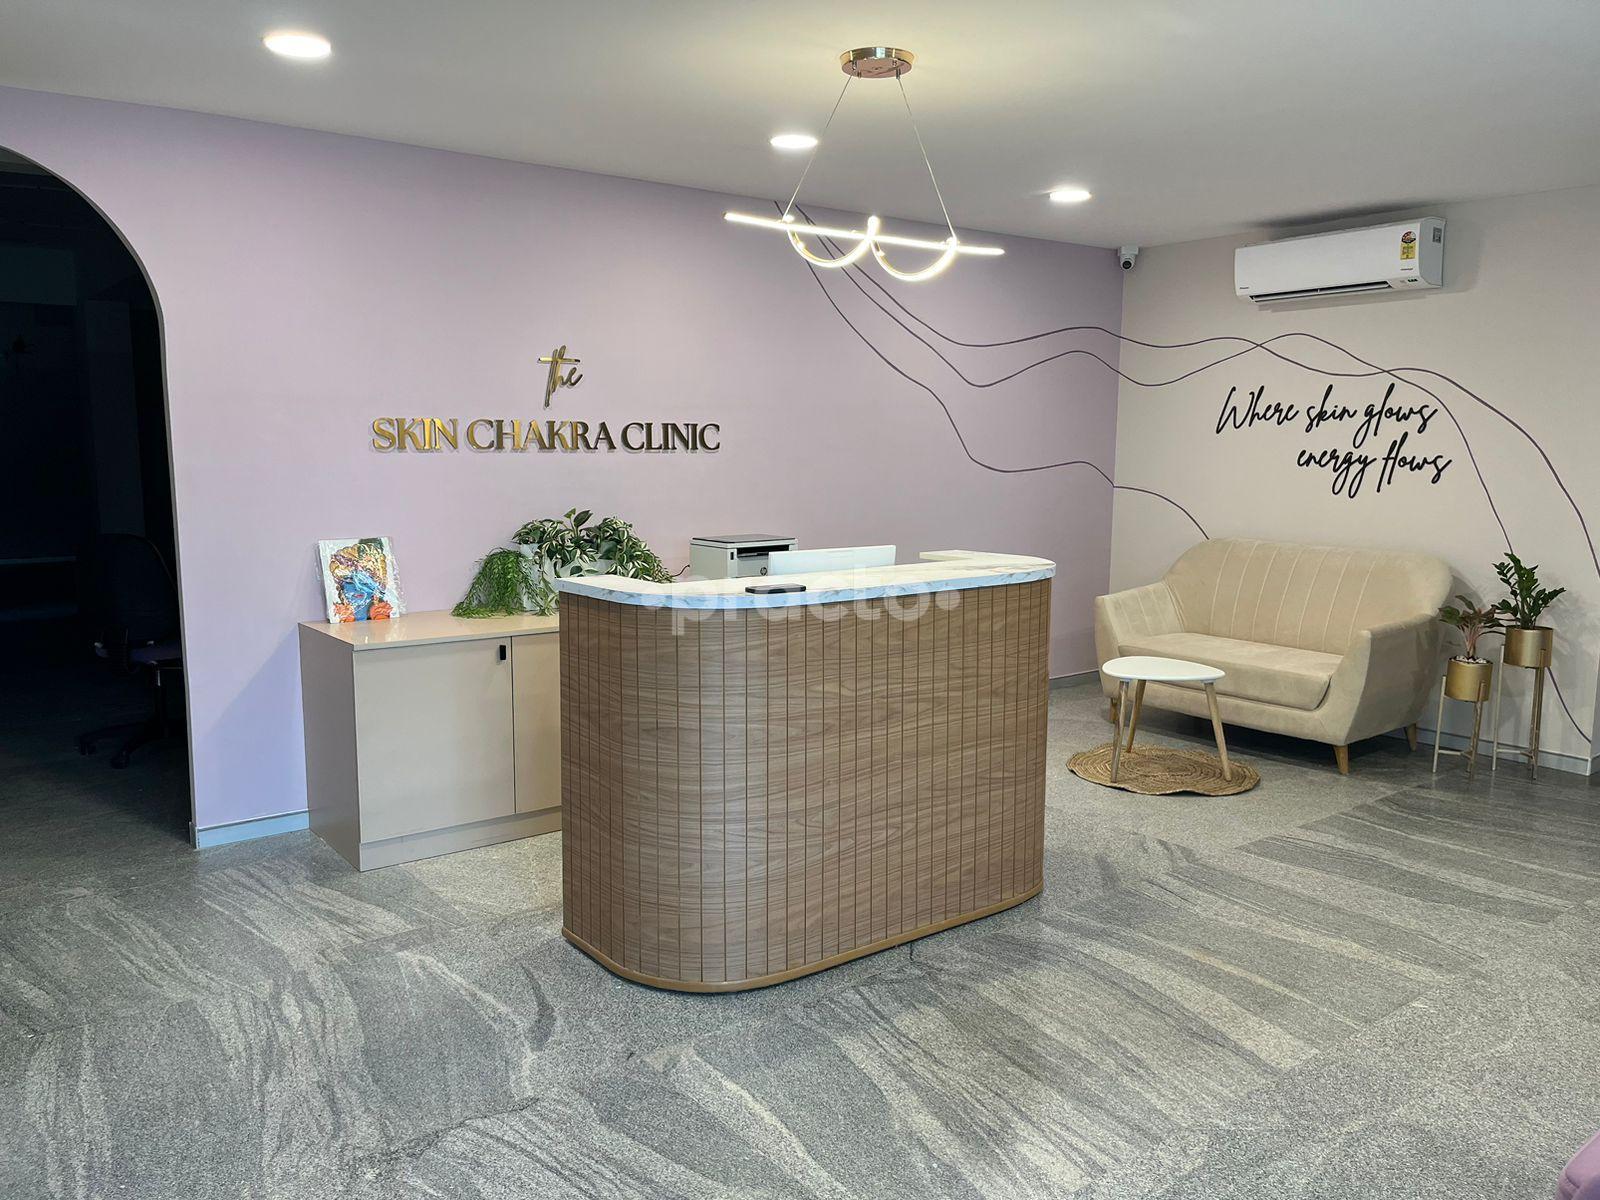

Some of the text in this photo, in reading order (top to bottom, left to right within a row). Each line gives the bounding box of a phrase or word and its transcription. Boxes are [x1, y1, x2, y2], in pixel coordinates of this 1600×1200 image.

[537, 345, 583, 410] the
[371, 417, 721, 453] SKIN CHAKRA CLINIC
[1216, 383, 1438, 449] Where skin glows
[1297, 431, 1452, 499] energy flows
